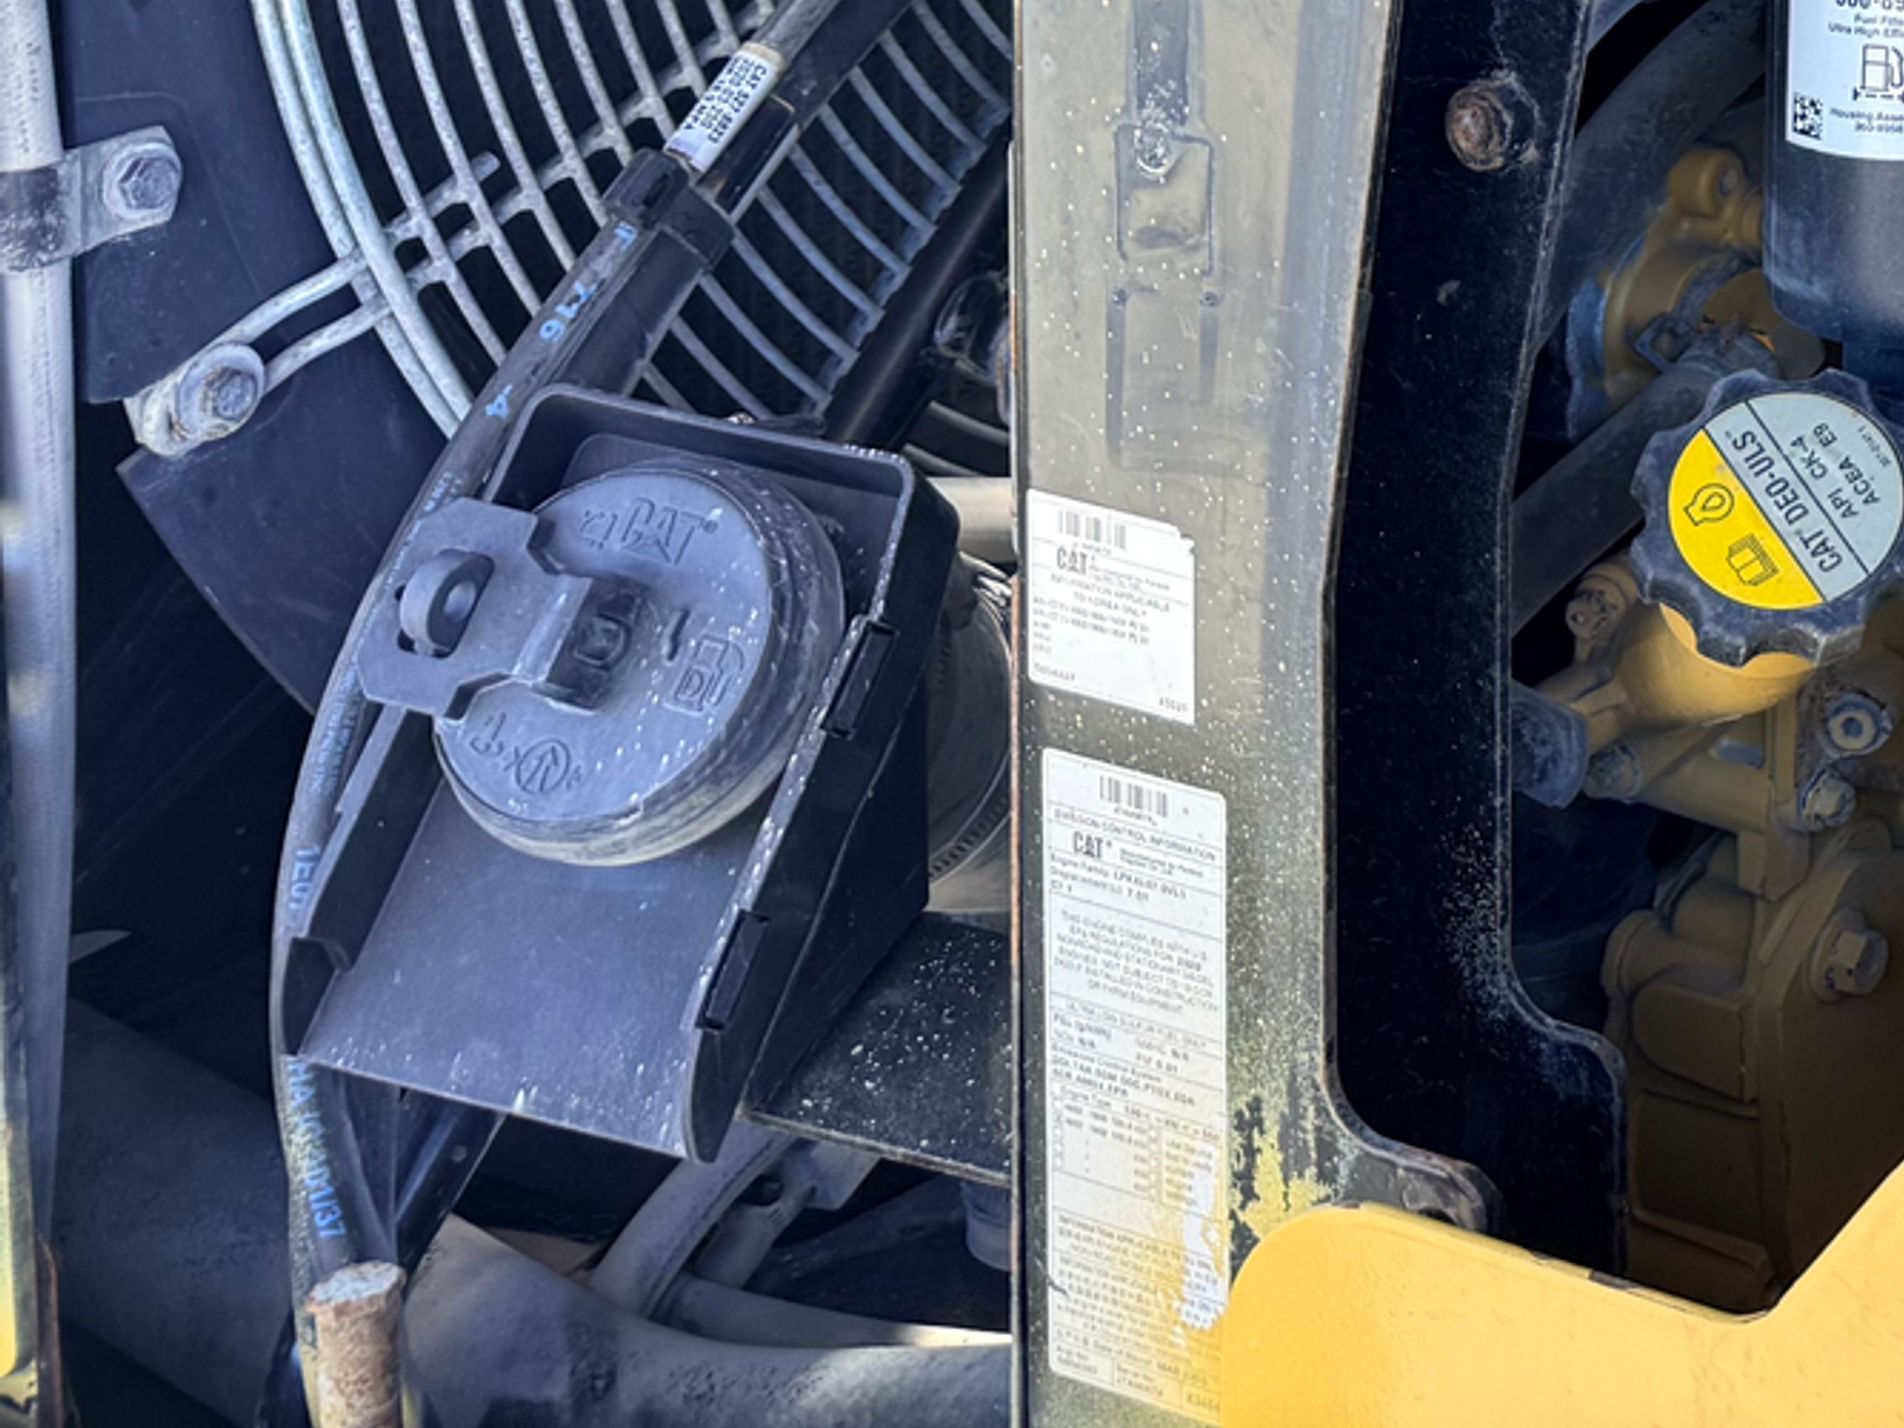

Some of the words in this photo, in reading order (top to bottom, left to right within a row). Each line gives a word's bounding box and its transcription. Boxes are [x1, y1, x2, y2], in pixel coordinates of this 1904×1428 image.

[1854, 25, 1881, 39] High
[1790, 437, 1829, 479] CK-4
[1838, 456, 1882, 507] ACEA
[1827, 487, 1860, 520] API
[1056, 545, 1089, 576] CAT
[1801, 530, 1843, 574] CAT
